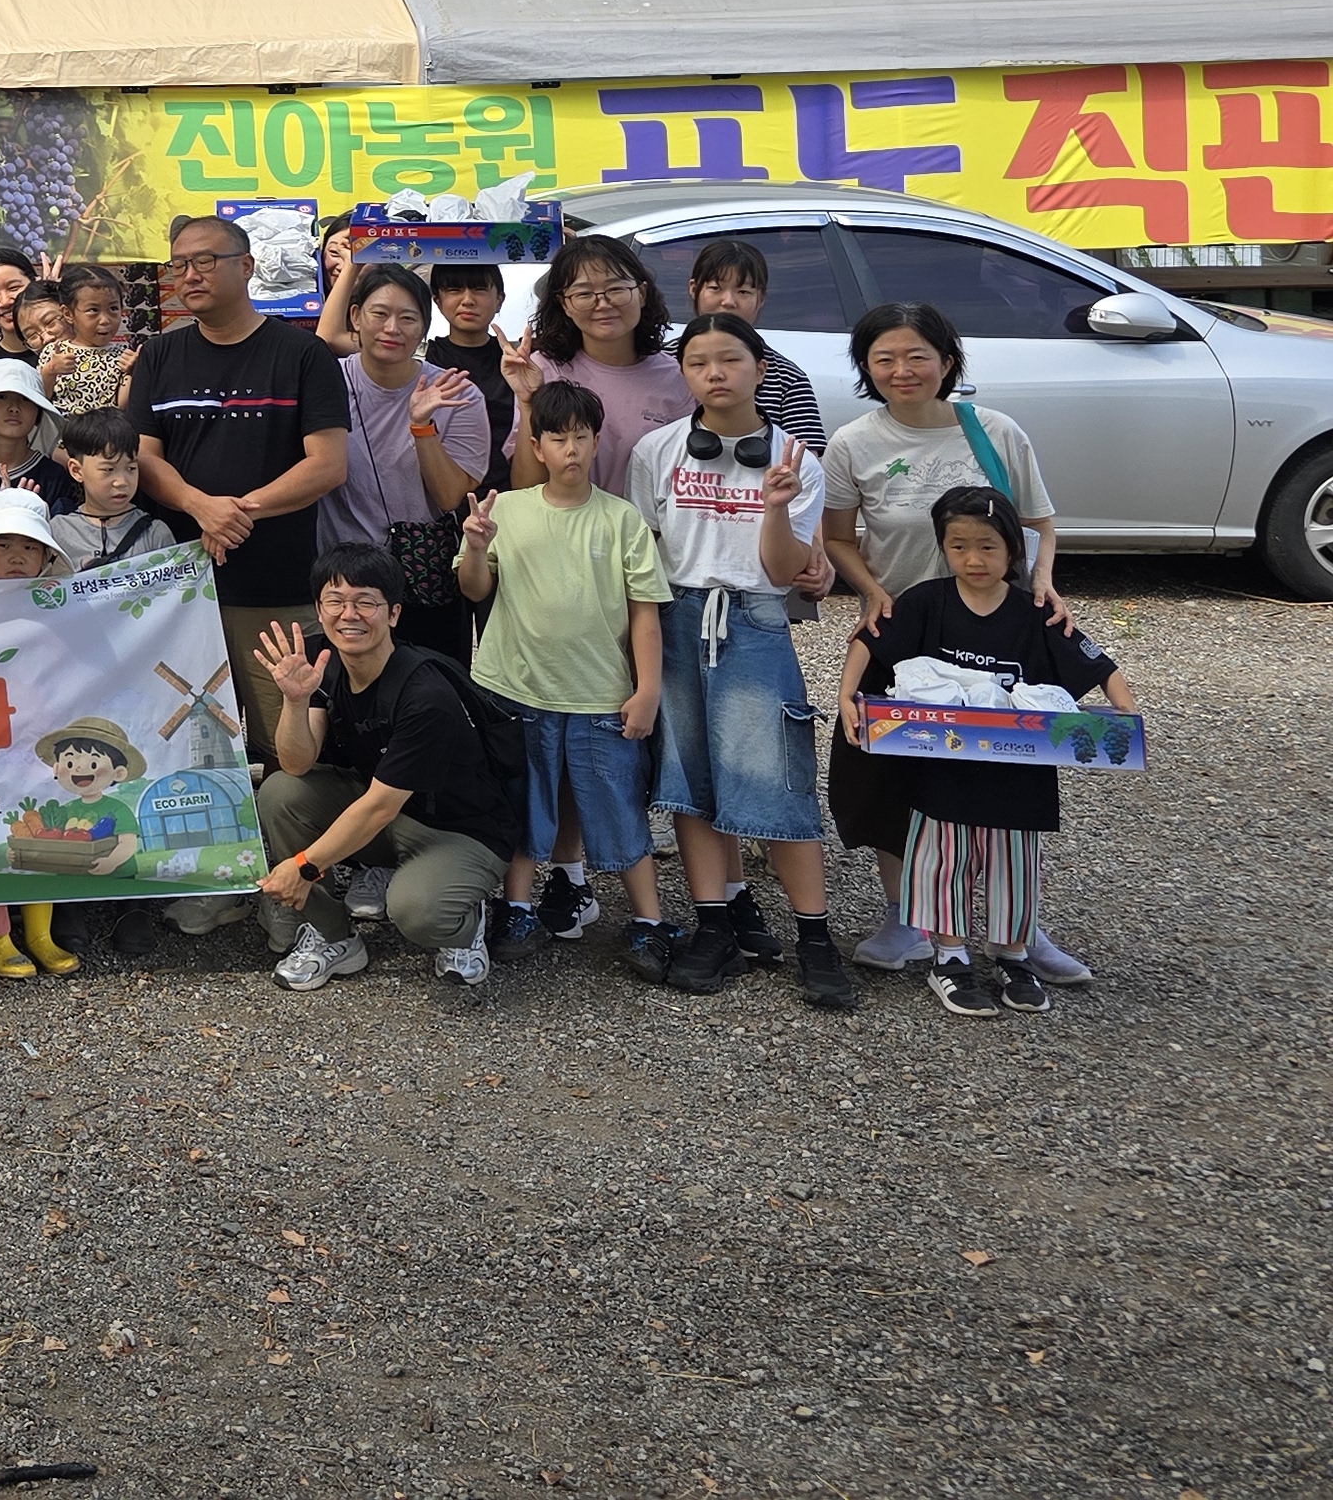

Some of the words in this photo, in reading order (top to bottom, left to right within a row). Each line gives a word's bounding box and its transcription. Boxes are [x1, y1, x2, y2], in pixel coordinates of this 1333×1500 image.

[164, 94, 557, 195] 진아농원
[1246, 419, 1274, 427] VVT
[674, 466, 726, 486] FRUIT
[674, 480, 764, 502] CONNECTI
[71, 562, 197, 595] 화성푸드통합지원센터
[955, 649, 996, 667] KPOP
[154, 799, 177, 810] ECO
[179, 794, 210, 807] FARM
